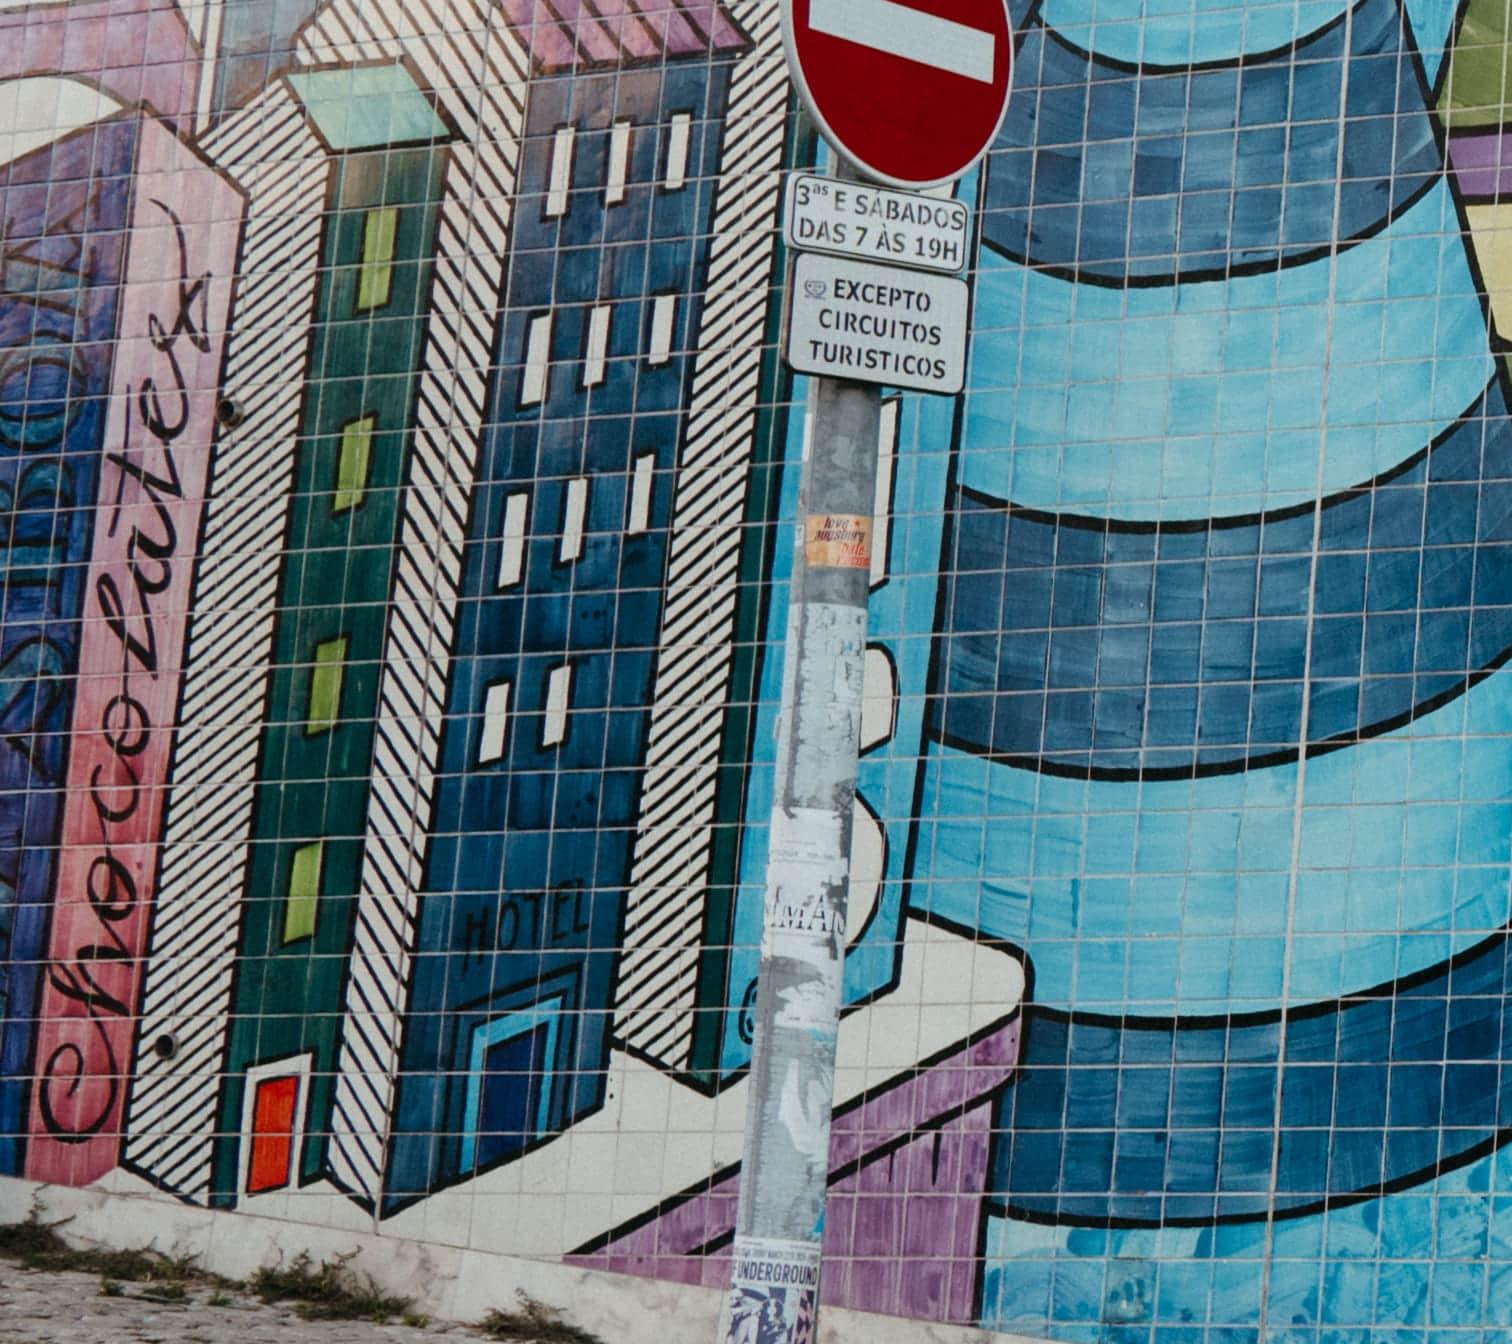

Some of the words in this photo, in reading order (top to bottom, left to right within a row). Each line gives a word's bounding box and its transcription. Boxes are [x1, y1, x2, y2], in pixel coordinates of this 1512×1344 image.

[834, 191, 847, 212] E
[855, 189, 964, 231] SÁBADOS
[800, 218, 847, 244] DAS
[855, 227, 868, 246] 7
[876, 224, 905, 253] ÀS
[914, 236, 958, 262] 19H
[834, 278, 931, 313] EXCEPTO
[819, 308, 941, 346] CIRCUITOS
[809, 340, 946, 379] TURISTICOS
[40, 198, 212, 1143] Chocolates
[461, 877, 590, 979] HOTEL
[737, 1261, 818, 1285] UNDERGROUND
